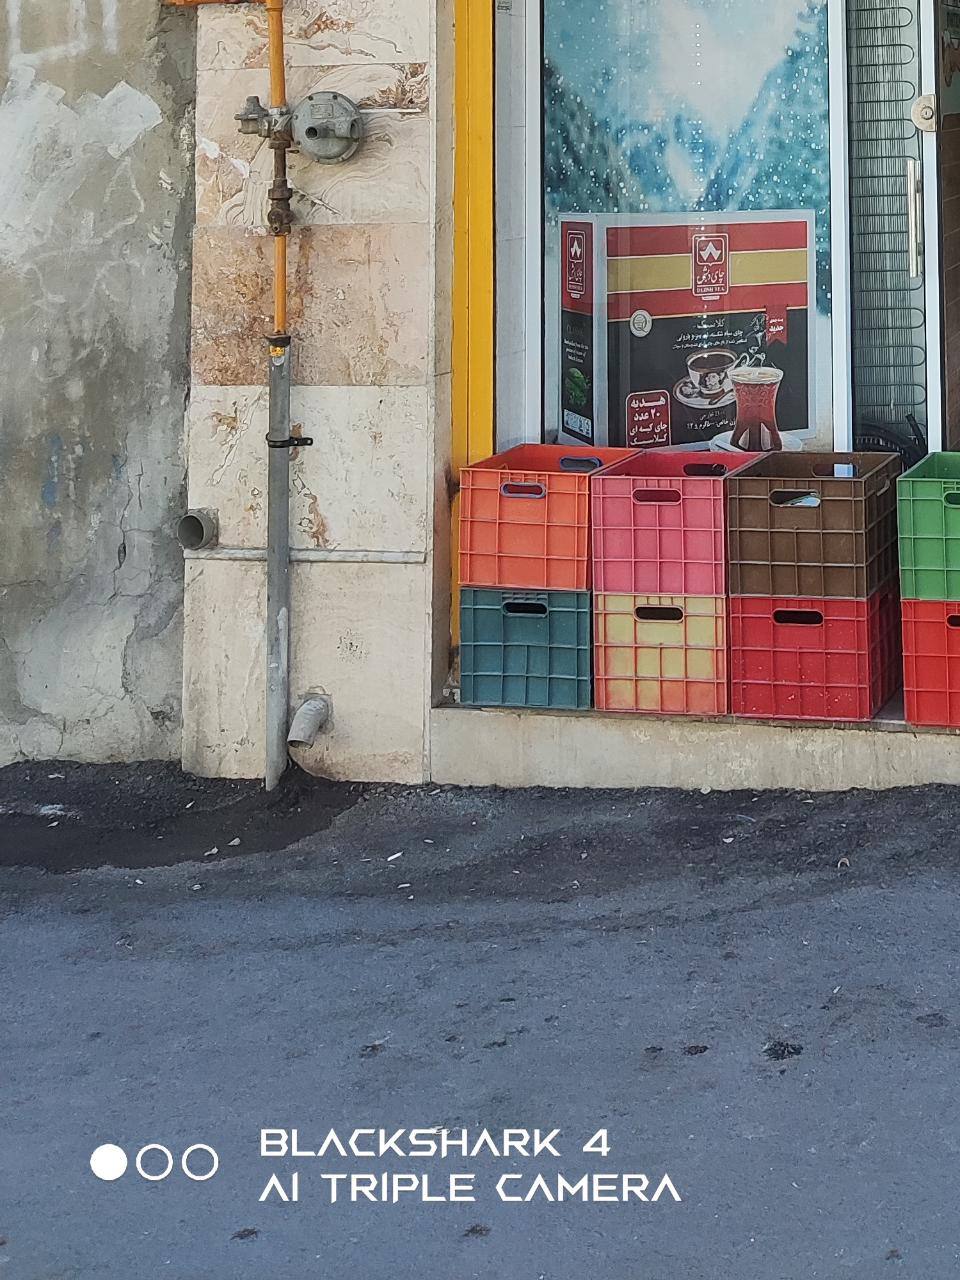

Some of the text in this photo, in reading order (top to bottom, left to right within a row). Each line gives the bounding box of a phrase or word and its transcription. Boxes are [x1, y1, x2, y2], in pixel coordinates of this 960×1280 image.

[631, 396, 665, 410] هدیه
[634, 408, 660, 420] ۲۰ عدد
[655, 421, 667, 432] چای
